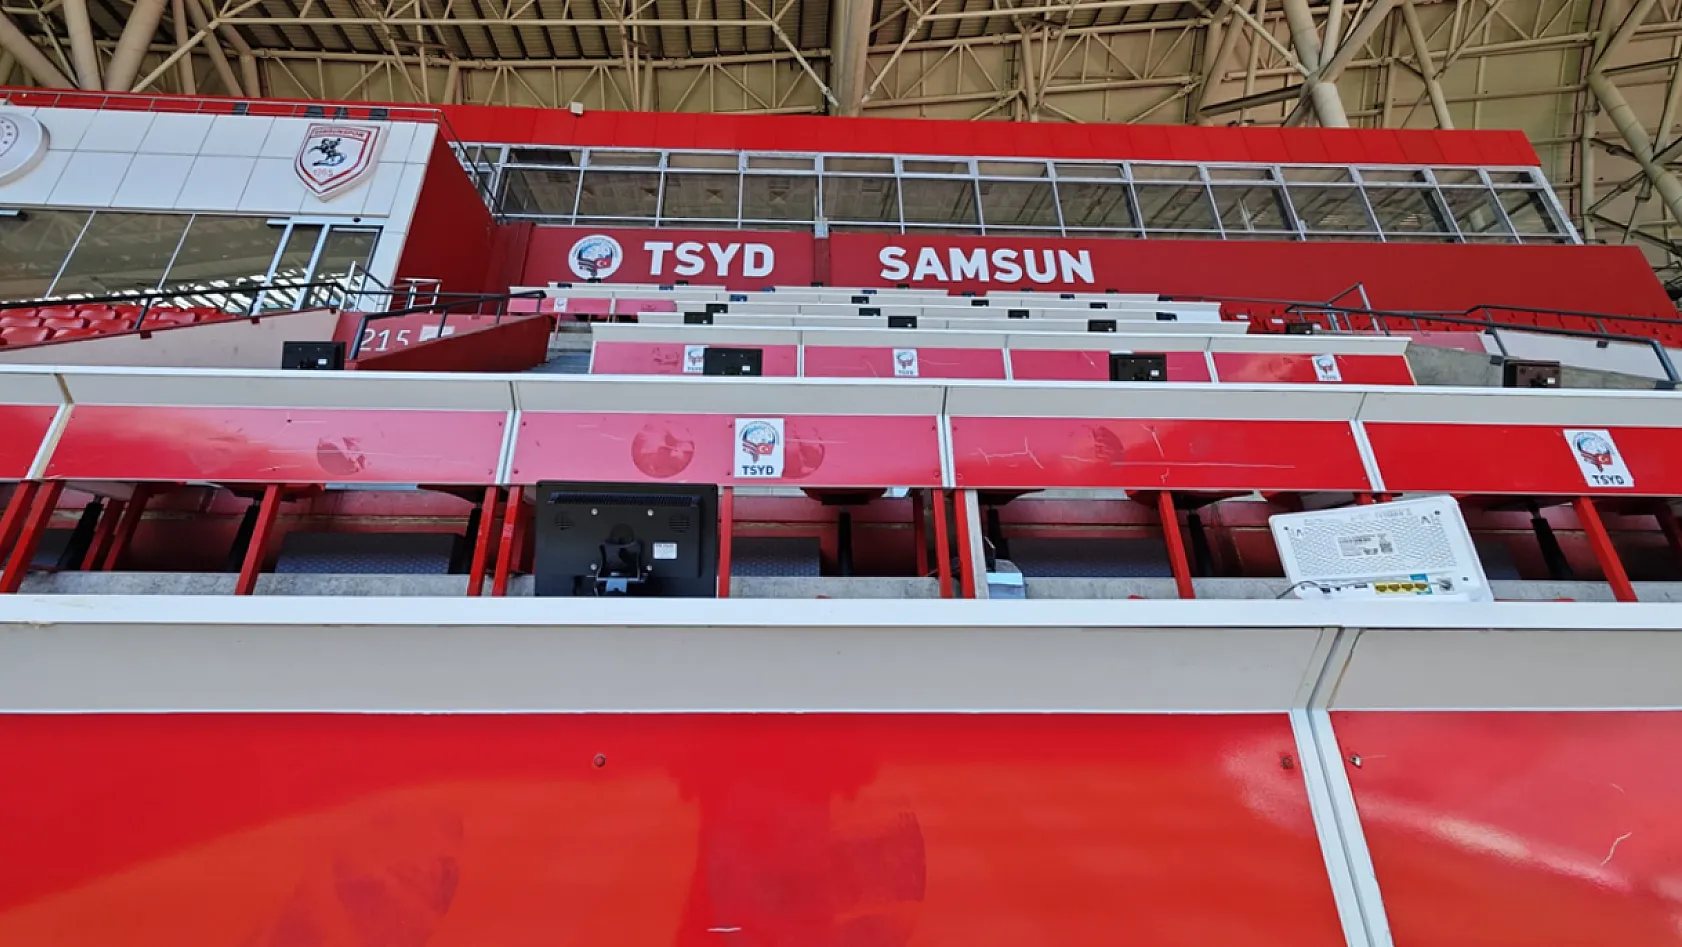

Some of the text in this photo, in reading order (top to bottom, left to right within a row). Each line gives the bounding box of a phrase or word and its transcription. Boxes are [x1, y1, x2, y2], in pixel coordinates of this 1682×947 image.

[643, 241, 775, 277] TSYD
[879, 246, 1095, 284] SAMSUN
[359, 329, 411, 352] 215
[742, 465, 774, 476] TSYD
[1591, 474, 1625, 486] TSYD
